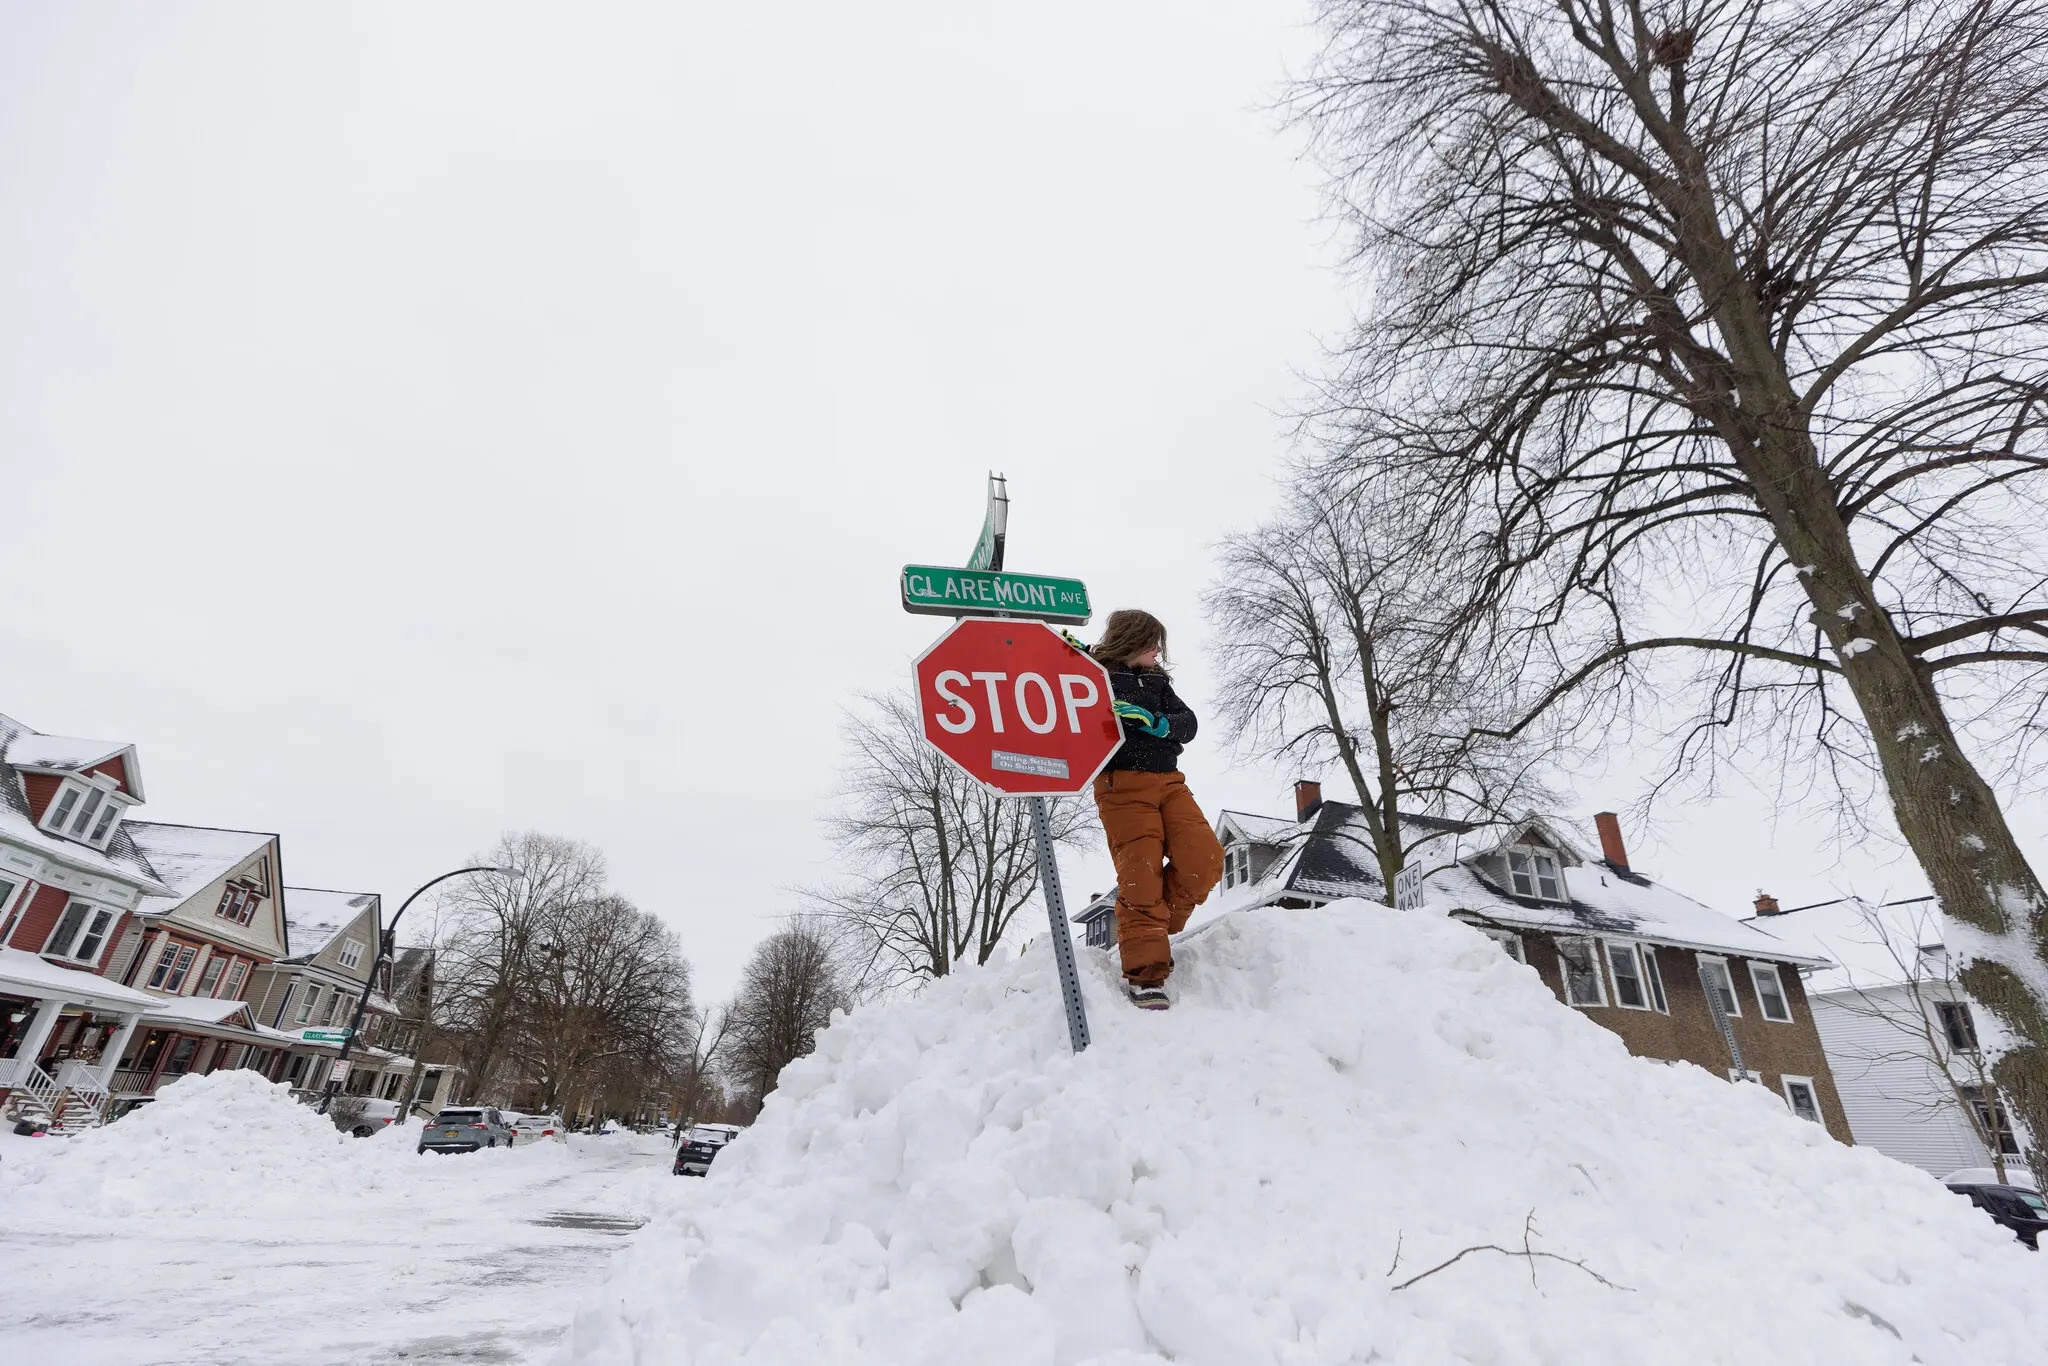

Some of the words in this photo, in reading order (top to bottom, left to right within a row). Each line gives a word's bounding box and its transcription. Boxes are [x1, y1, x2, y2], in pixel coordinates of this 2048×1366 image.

[909, 575, 1057, 607] CLAREMONT
[1060, 592, 1083, 605] AVE
[934, 670, 1099, 734] STOP
[993, 752, 1028, 766] Putting
[1029, 757, 1067, 769] Stickers
[1000, 760, 1013, 768] On
[1015, 762, 1036, 773] Stop
[1037, 765, 1061, 775] Signs
[1398, 868, 1419, 894] ONE
[1398, 889, 1420, 911] WAY
